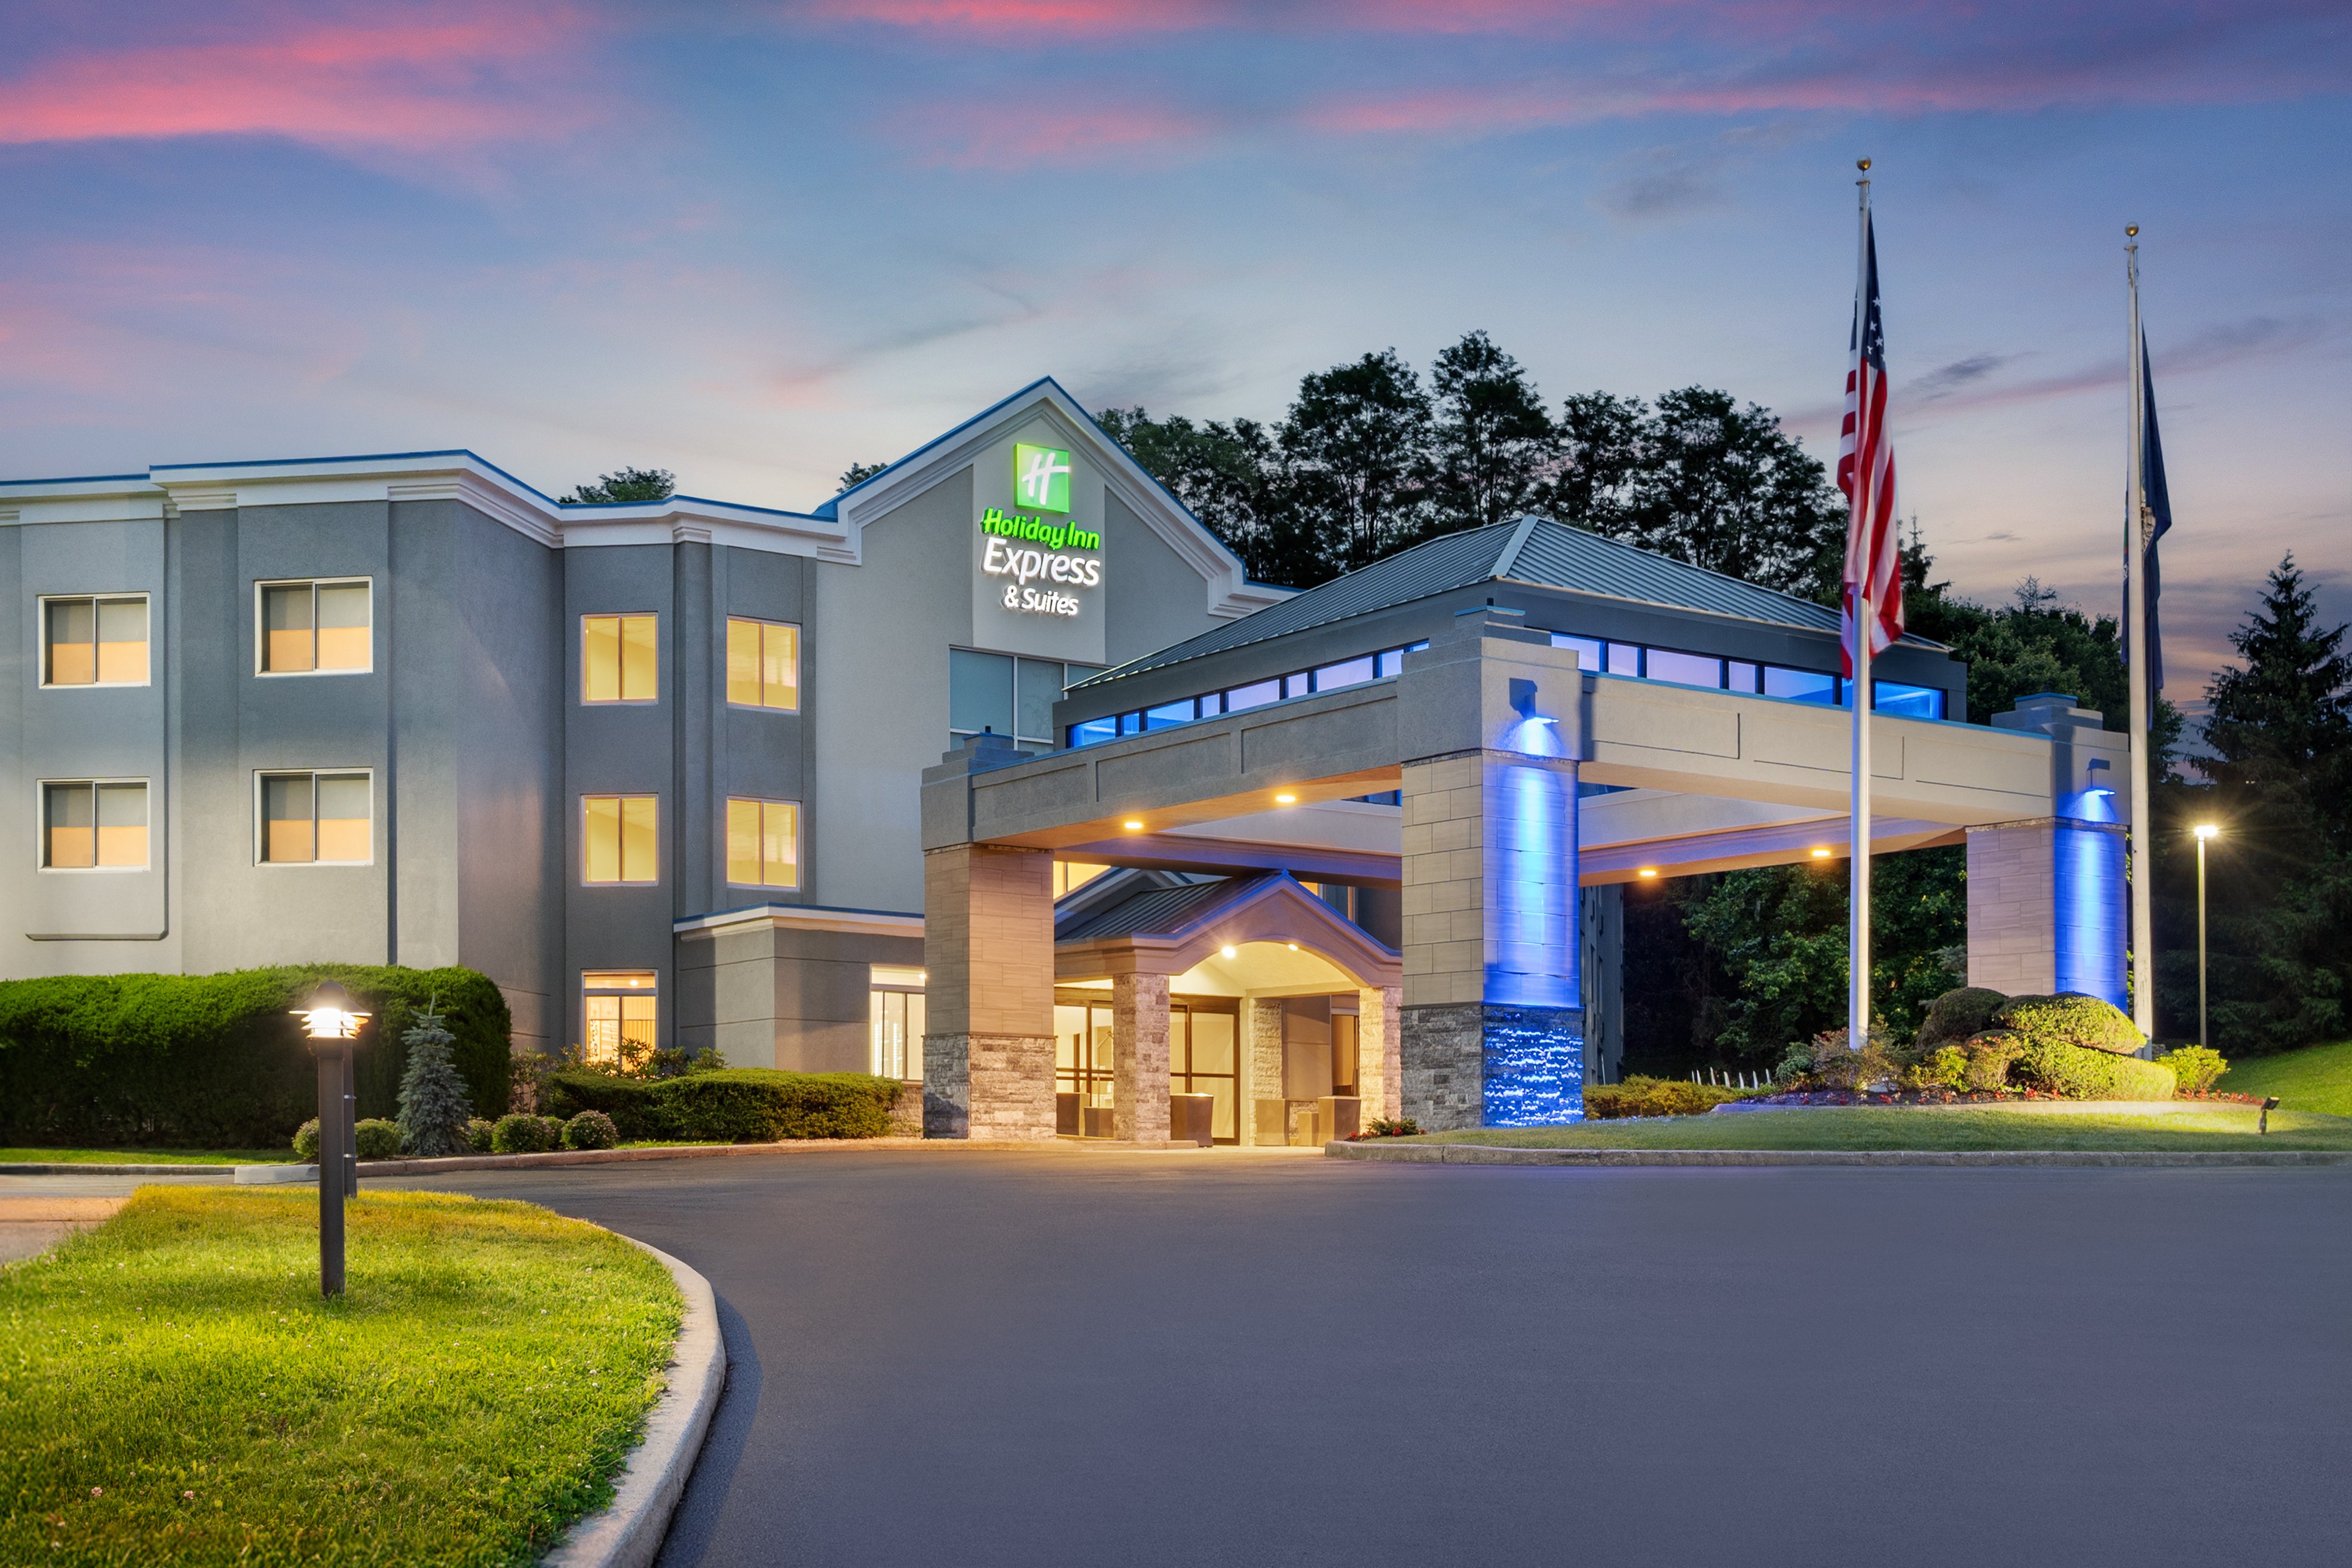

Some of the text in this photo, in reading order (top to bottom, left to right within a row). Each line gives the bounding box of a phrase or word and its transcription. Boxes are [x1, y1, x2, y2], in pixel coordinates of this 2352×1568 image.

[982, 508, 1100, 549] Holiday Inn
[983, 537, 1100, 586] Express
[1003, 586, 1079, 615] & Suites
